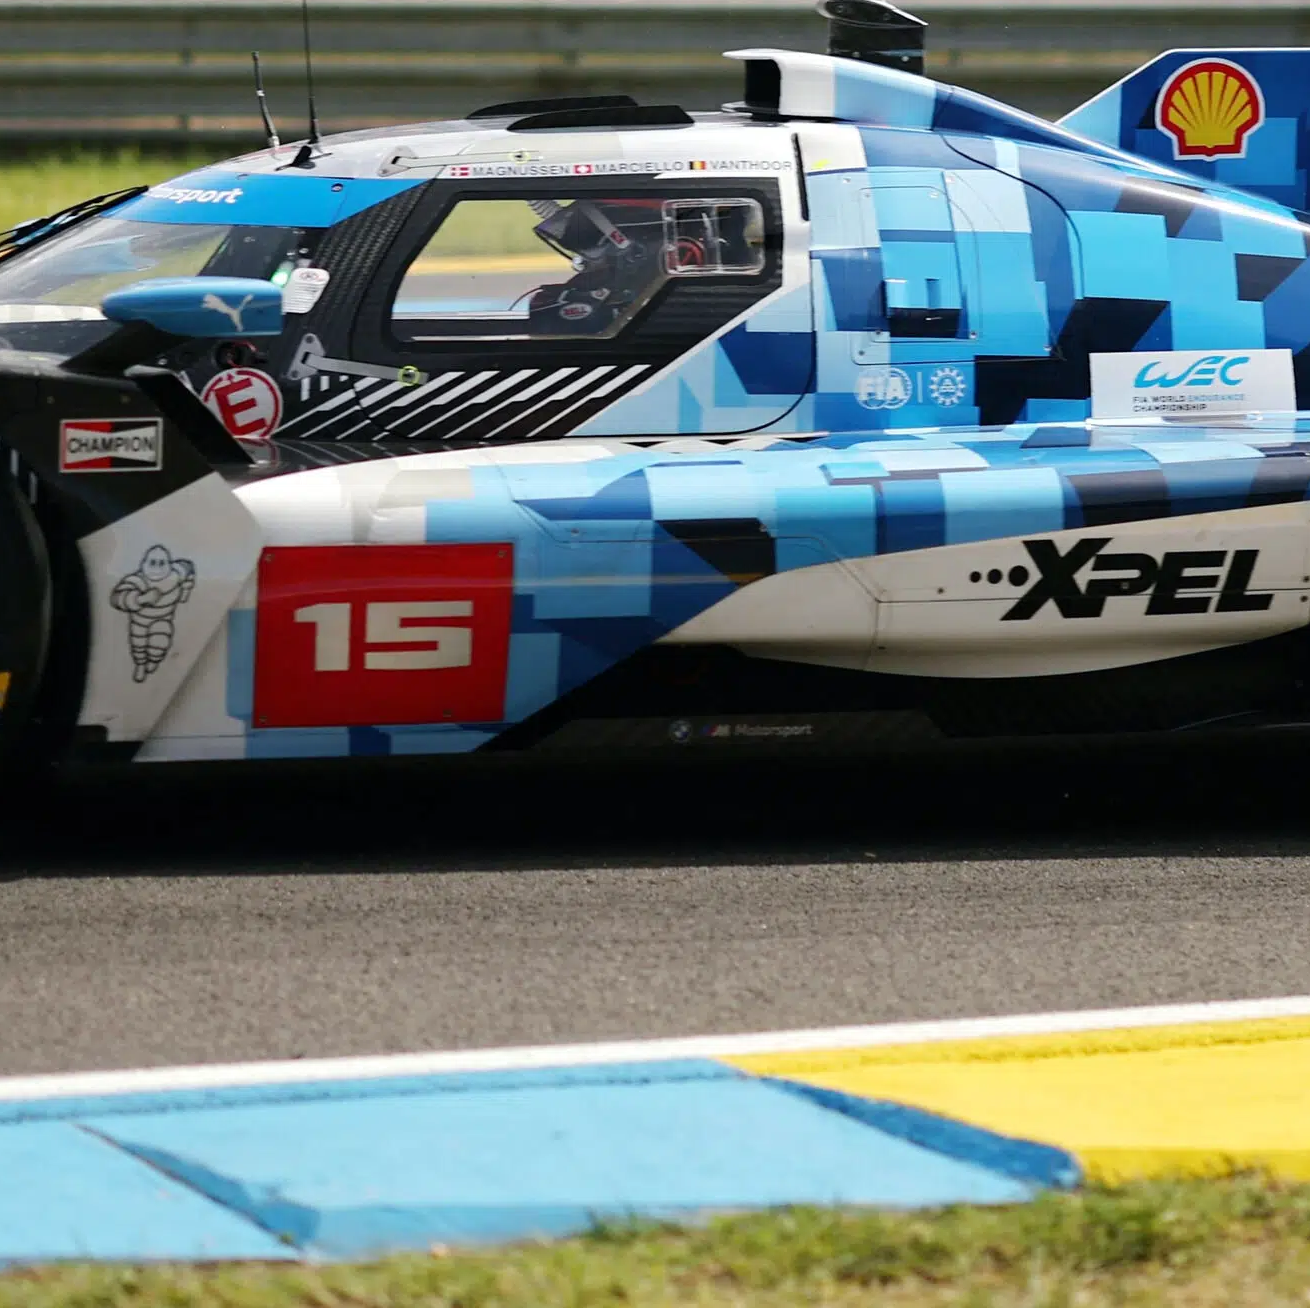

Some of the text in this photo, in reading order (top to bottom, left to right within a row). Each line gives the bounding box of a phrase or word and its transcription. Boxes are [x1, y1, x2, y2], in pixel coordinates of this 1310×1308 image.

[473, 159, 792, 176] MAGNUSSEN MARCIELLO VANTHOOR
[1133, 356, 1250, 388] WEC
[858, 376, 904, 401] FIA
[67, 436, 155, 454] CHAMPION
[1000, 538, 1275, 621] XPEL
[294, 601, 472, 671] 15
